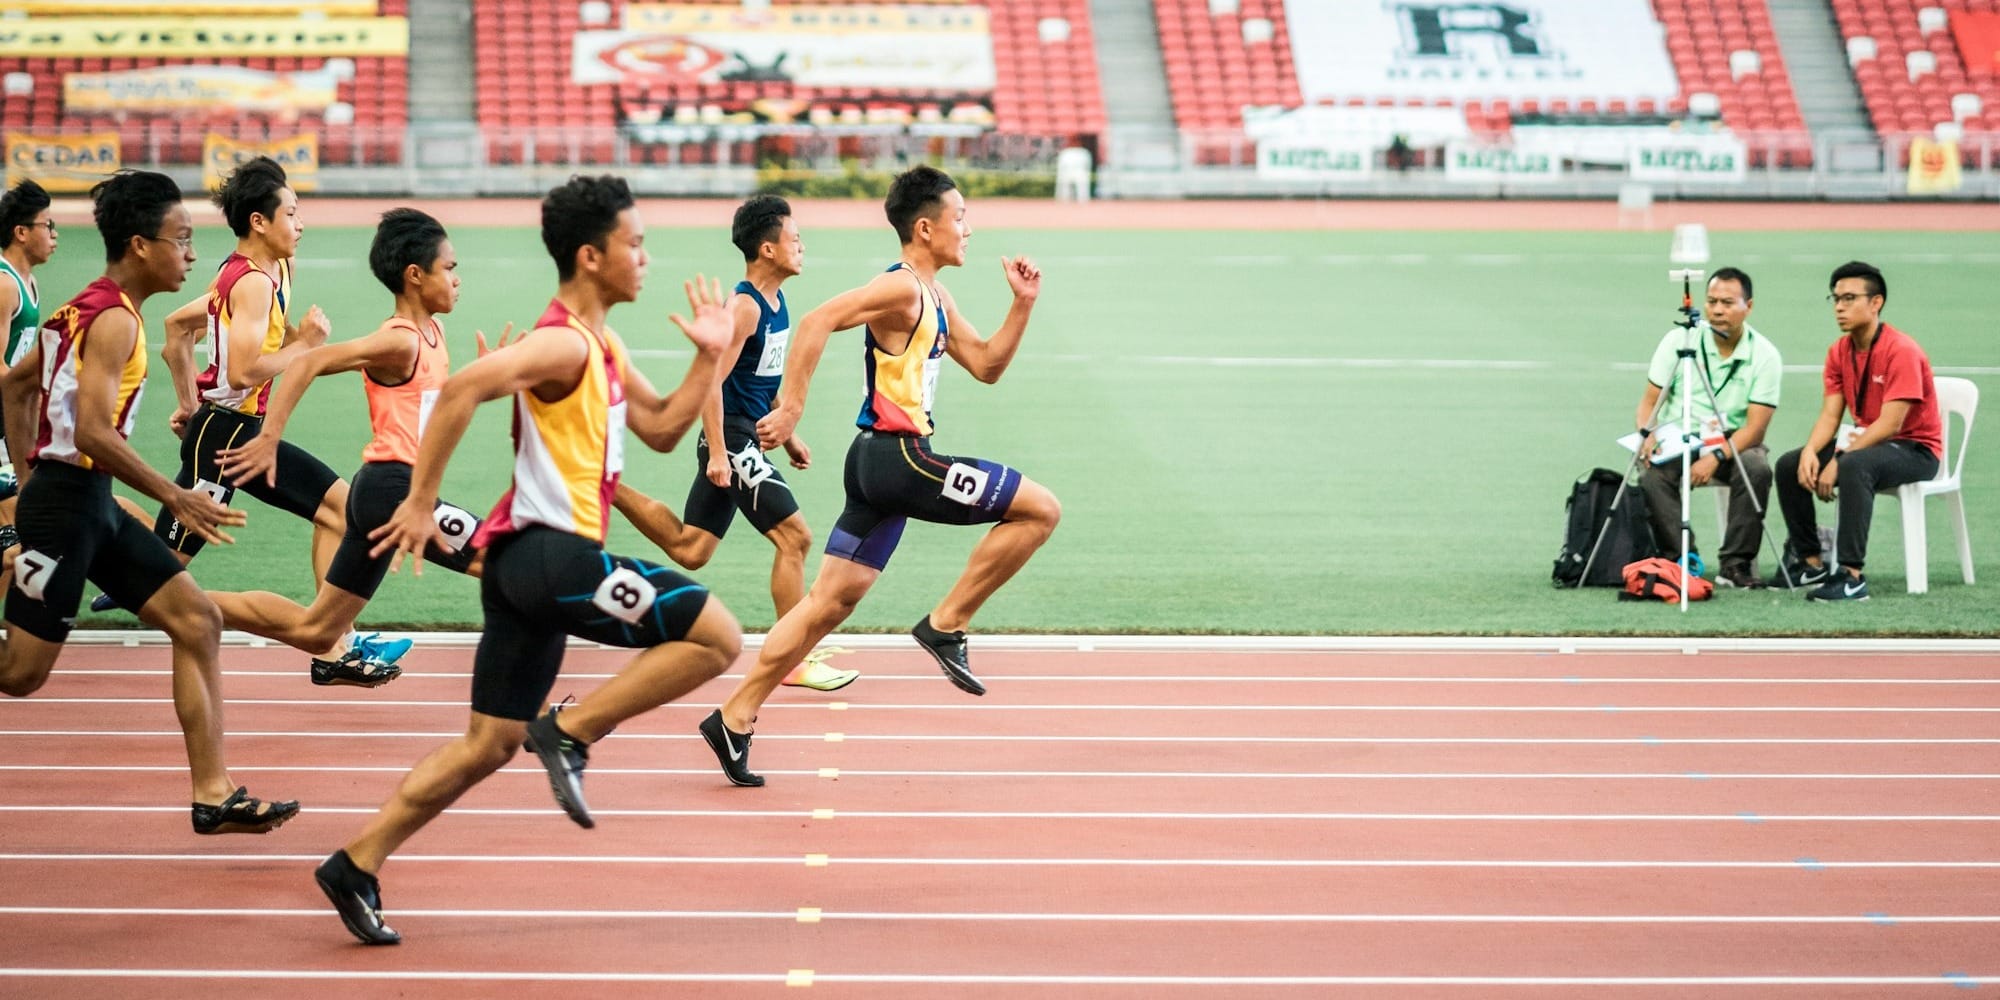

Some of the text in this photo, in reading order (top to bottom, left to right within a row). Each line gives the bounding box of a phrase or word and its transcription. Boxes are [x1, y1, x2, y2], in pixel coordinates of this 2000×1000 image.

[13, 143, 114, 166] CEDAR
[741, 456, 764, 480] 2
[952, 472, 976, 496] 5
[438, 513, 465, 537] 6
[22, 557, 45, 587] 7
[610, 580, 641, 610] 8
